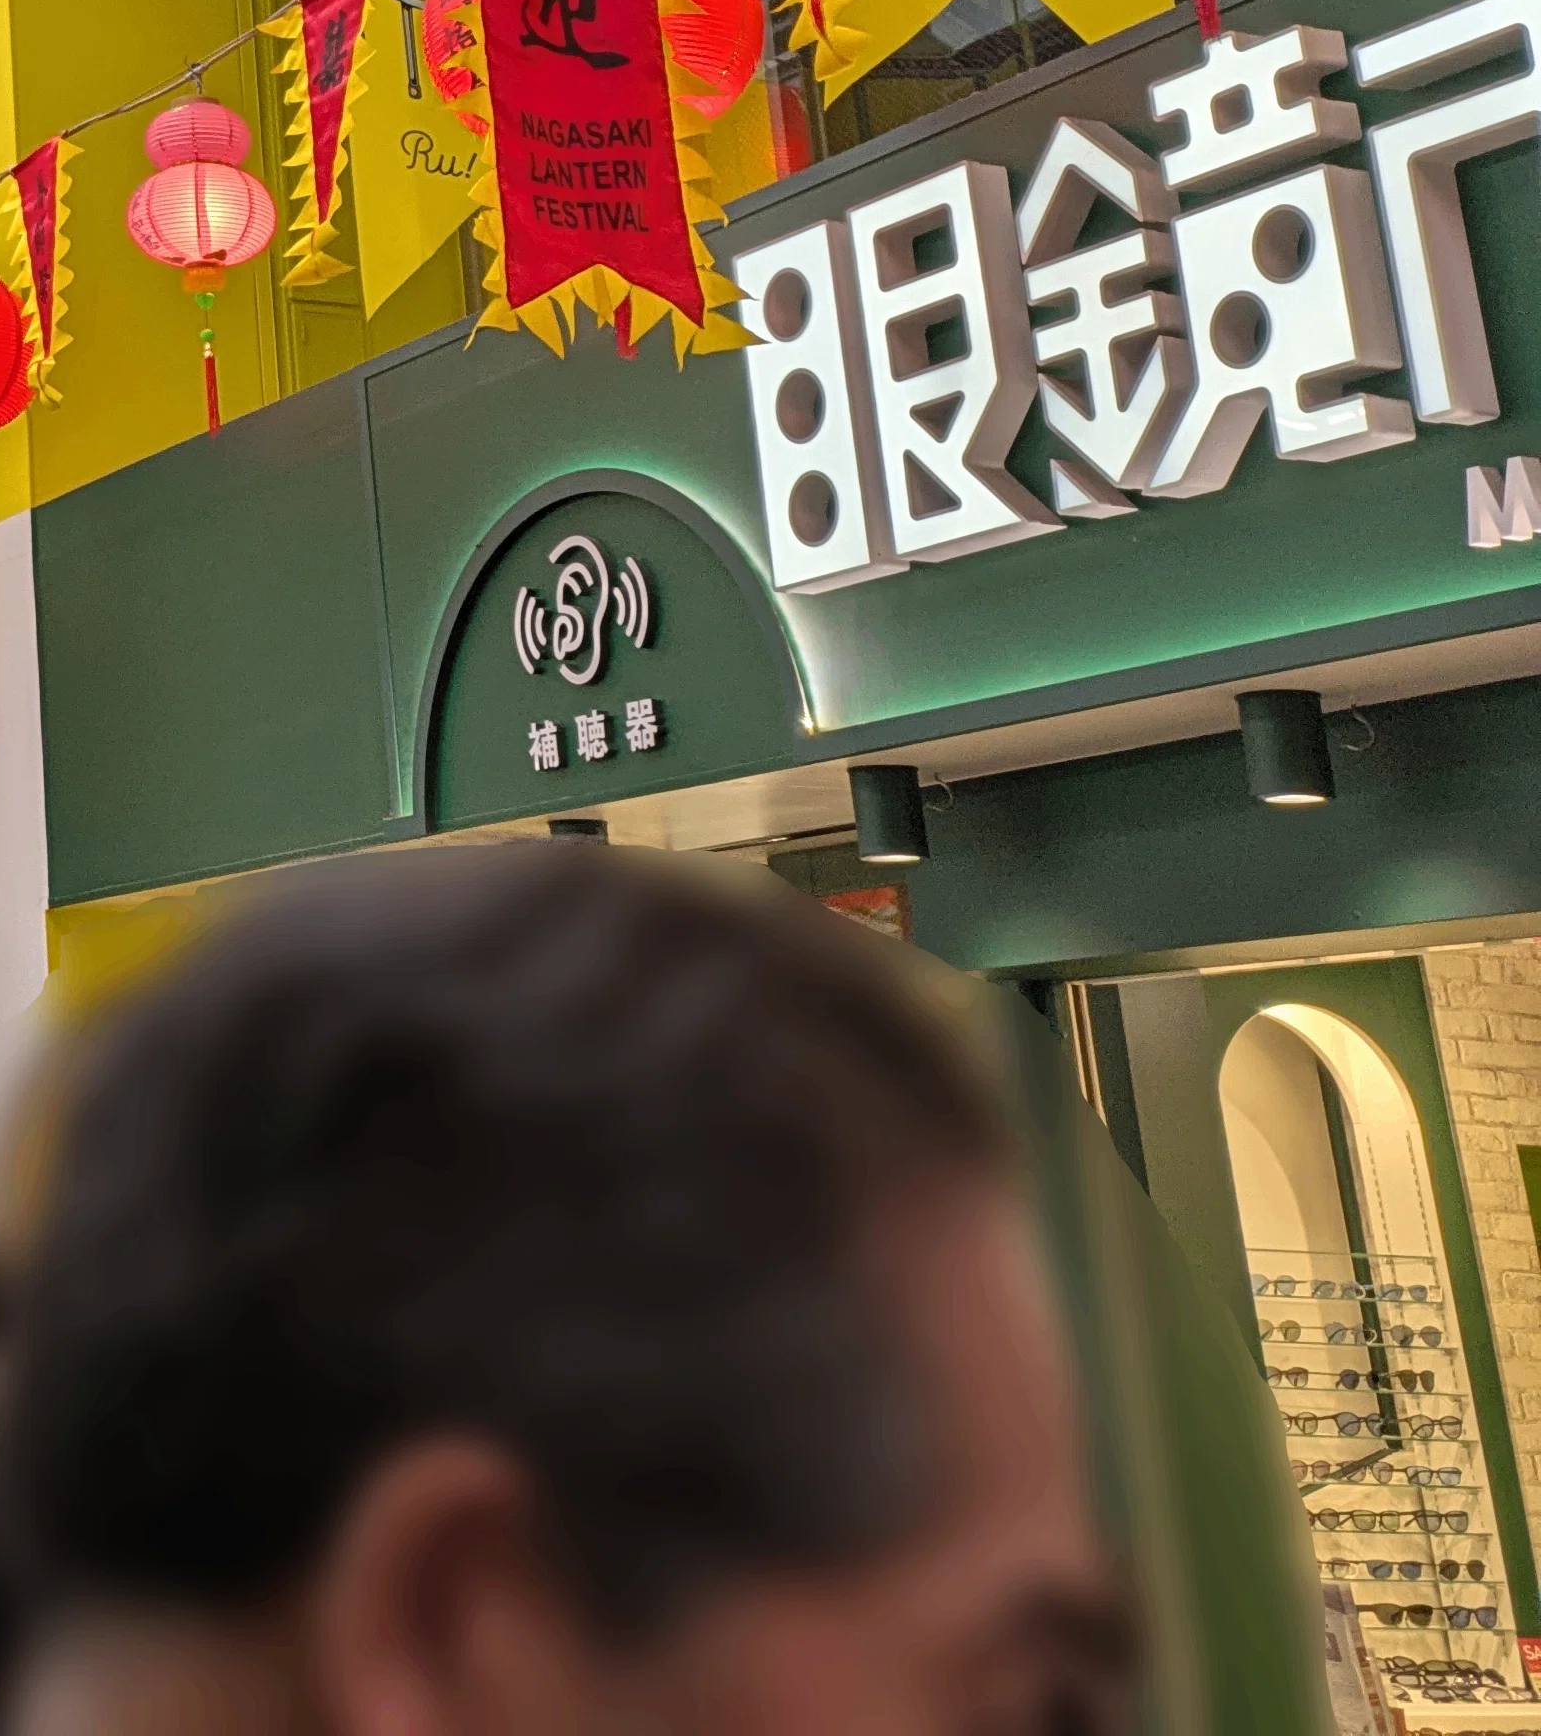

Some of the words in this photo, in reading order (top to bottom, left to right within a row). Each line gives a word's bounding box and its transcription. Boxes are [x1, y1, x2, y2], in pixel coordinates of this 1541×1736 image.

[520, 110, 653, 149] NAGASAKI
[400, 129, 478, 179] Ru!
[529, 153, 648, 191] LANTERN
[533, 198, 650, 234] FESTIVAL
[528, 698, 659, 771] 補聴器
